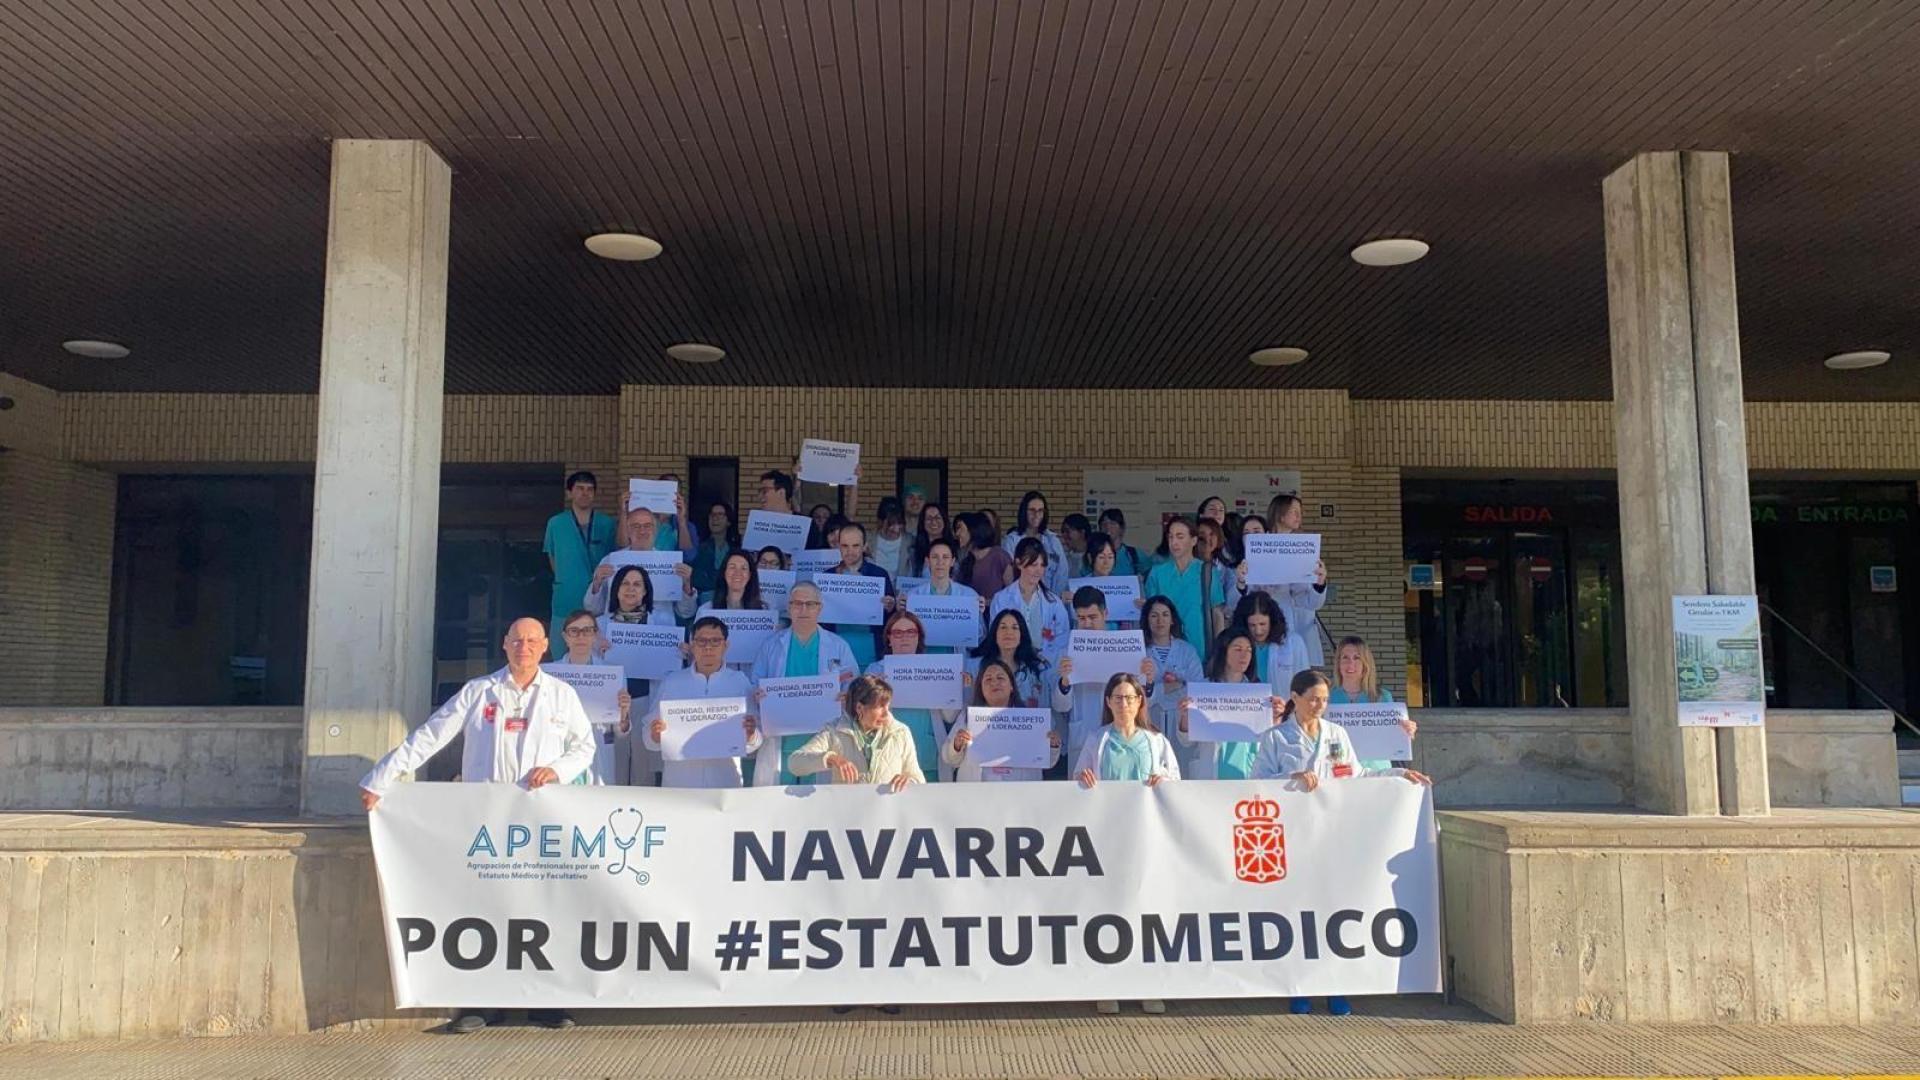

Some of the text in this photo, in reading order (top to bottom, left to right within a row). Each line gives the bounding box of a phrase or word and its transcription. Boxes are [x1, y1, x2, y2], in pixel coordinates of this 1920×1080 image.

[1463, 505, 1552, 521] SALIDA
[1798, 506, 1908, 522] ENTRADA
[625, 631, 680, 641] NEGOCIACIÓN,
[641, 639, 679, 648] SOLUCIÓN
[583, 672, 617, 680] RESPETO
[802, 682, 834, 690] RESPETO
[783, 690, 823, 698] LIDERAZGO
[706, 705, 739, 713] RESPETO
[686, 713, 728, 722] LIDERAZGO
[1012, 715, 1045, 723] RESPETO
[992, 723, 1033, 731] LIDERAZGO
[732, 826, 1104, 882] NAVARRA
[466, 861, 511, 870] Agrupación
[523, 862, 574, 870] Profesionales
[575, 863, 588, 871] por
[511, 871, 539, 880] Médico
[546, 872, 588, 880] Facultativo
[396, 908, 1418, 972] POR UN #ESTATUTOMEDICO
